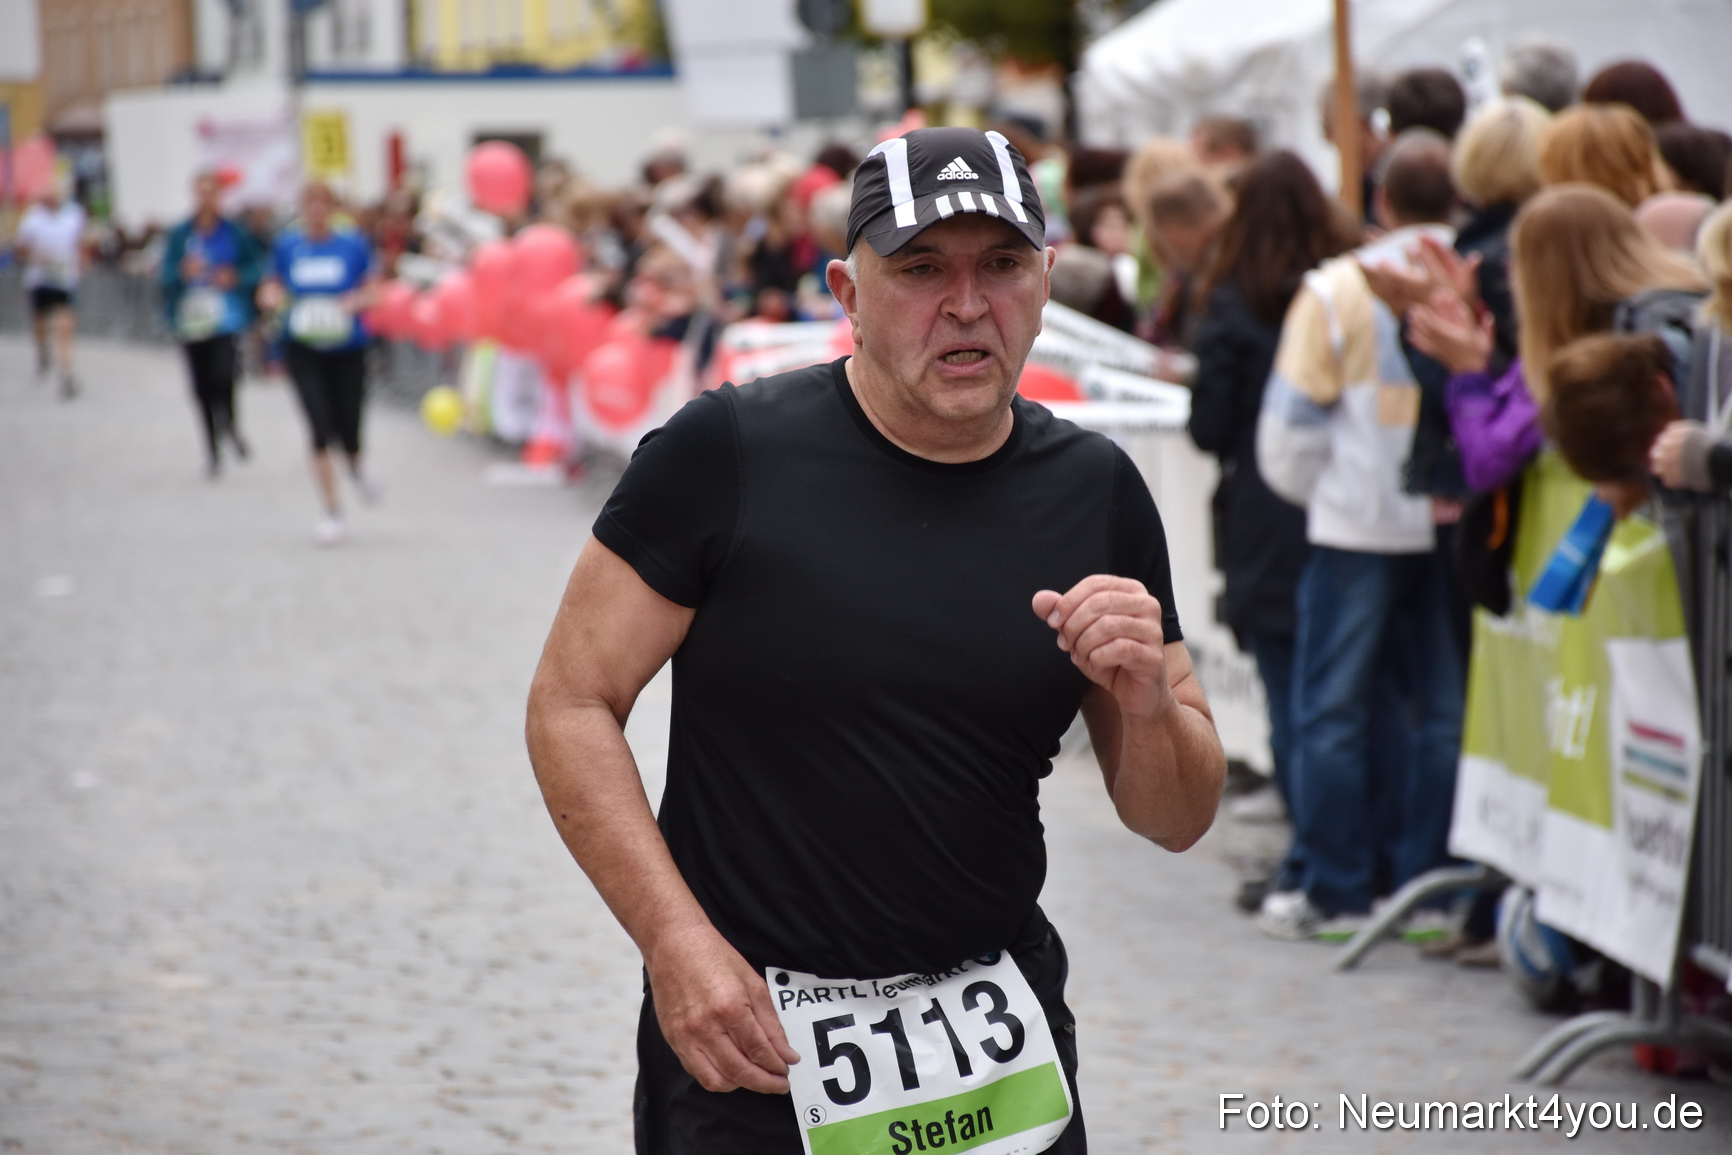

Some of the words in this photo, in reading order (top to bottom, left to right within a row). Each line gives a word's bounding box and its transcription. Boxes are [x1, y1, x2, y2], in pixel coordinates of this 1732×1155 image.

[936, 169, 979, 181] adidas
[778, 984, 868, 1011] PARTL
[811, 979, 1026, 1106] 5113
[809, 1107, 822, 1124] S
[888, 1105, 995, 1155] Stefan
